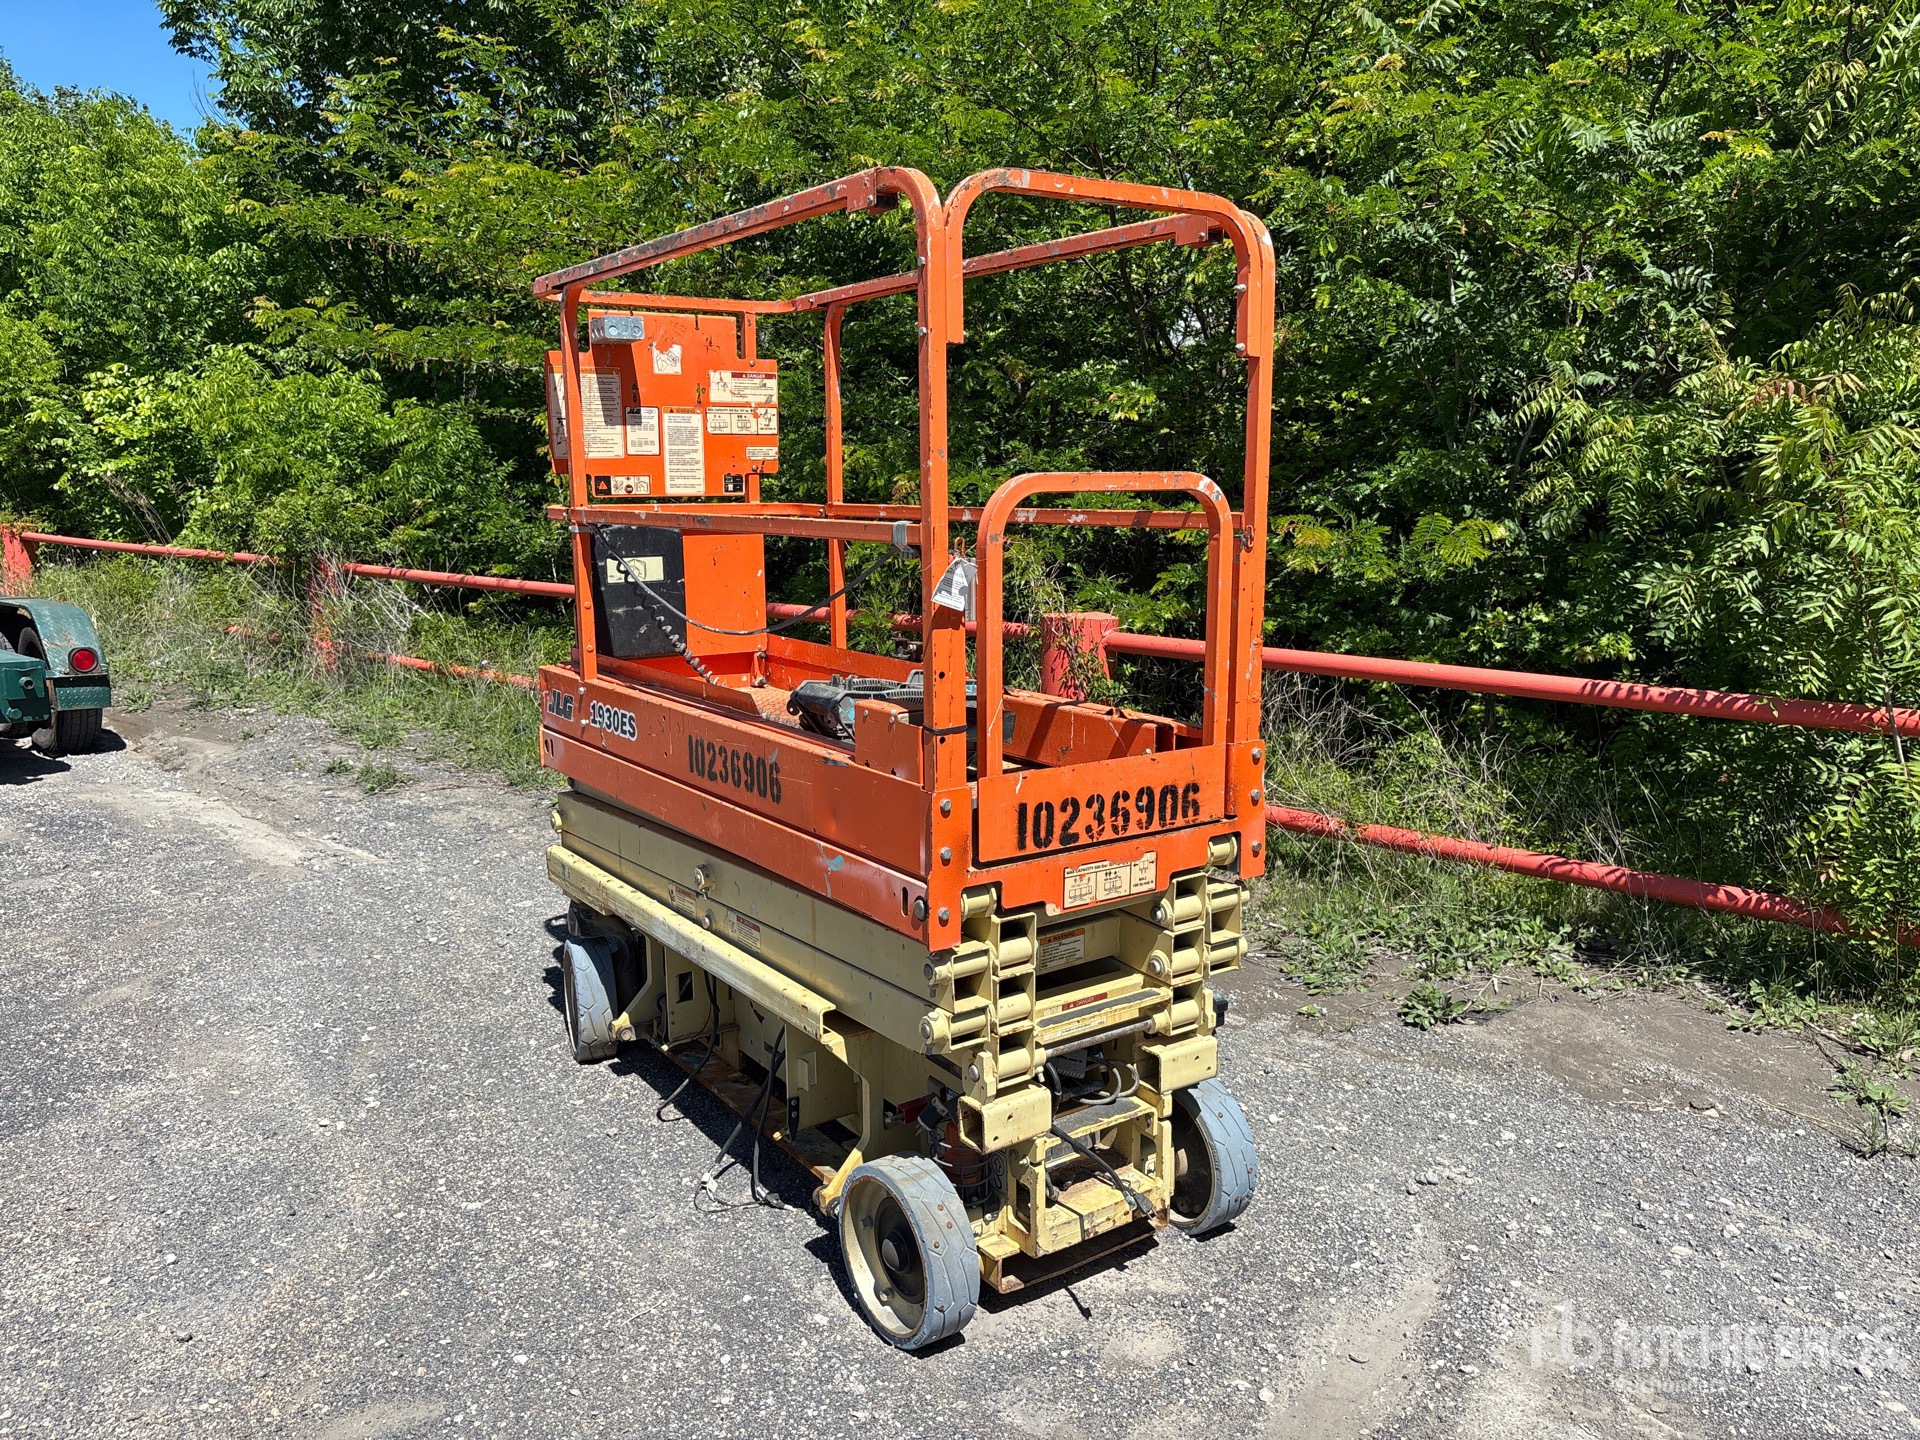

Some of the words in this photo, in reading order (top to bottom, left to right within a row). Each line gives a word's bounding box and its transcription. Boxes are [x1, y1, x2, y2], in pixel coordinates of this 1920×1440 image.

[548, 689, 575, 722] JLG
[590, 700, 638, 742] 1930ES
[687, 734, 783, 805] 10236906
[1016, 782, 1201, 852] 10236906
[1076, 866, 1093, 874] CAPACITY
[1053, 931, 1076, 941] WARNING
[1076, 996, 1095, 1007] DANGER
